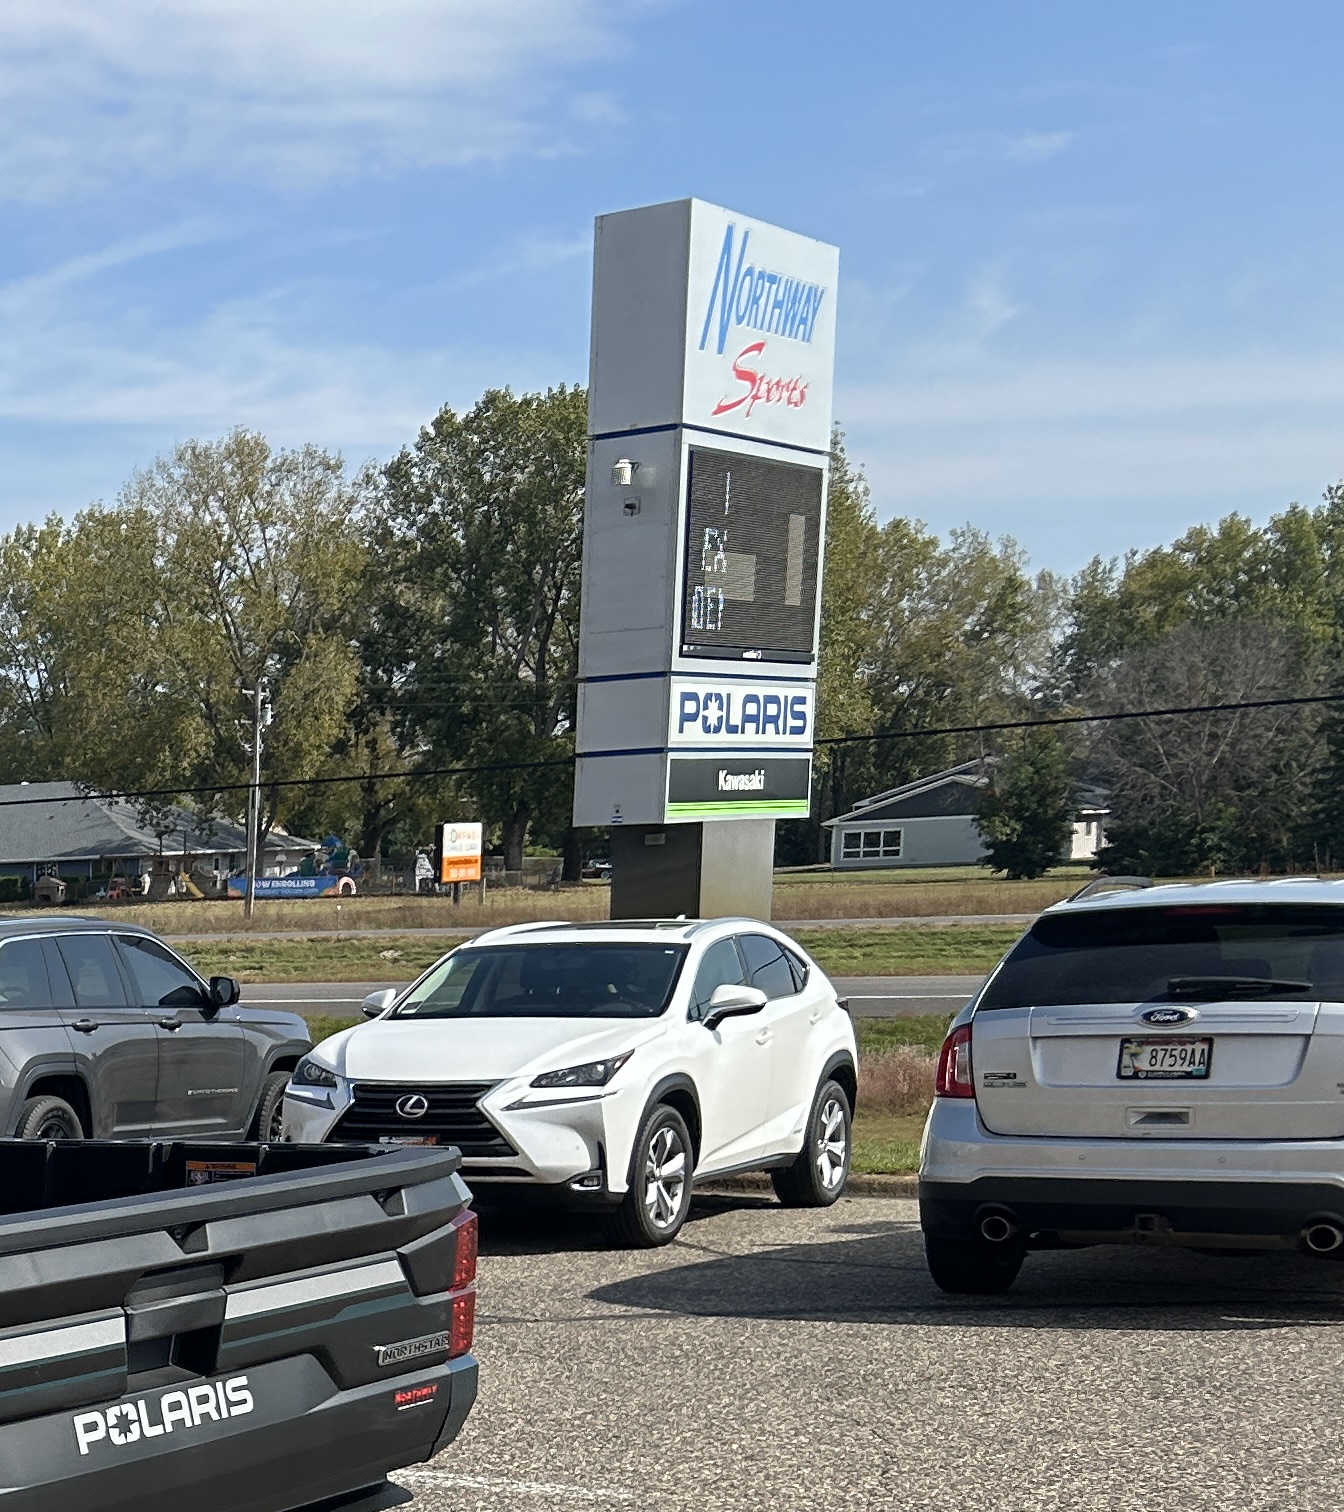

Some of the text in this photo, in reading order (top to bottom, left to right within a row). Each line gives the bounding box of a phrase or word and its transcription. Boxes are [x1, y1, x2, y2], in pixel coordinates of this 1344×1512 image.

[699, 222, 826, 355] NORTHWAY
[711, 340, 809, 419] Sports
[677, 691, 807, 735] POLARIS
[718, 769, 765, 791] Kawasaki
[1150, 1010, 1180, 1022] Ford
[1149, 1048, 1207, 1068] 8759AA
[383, 1335, 450, 1361] NORTHSTAR
[72, 1375, 254, 1455] POLARIS
